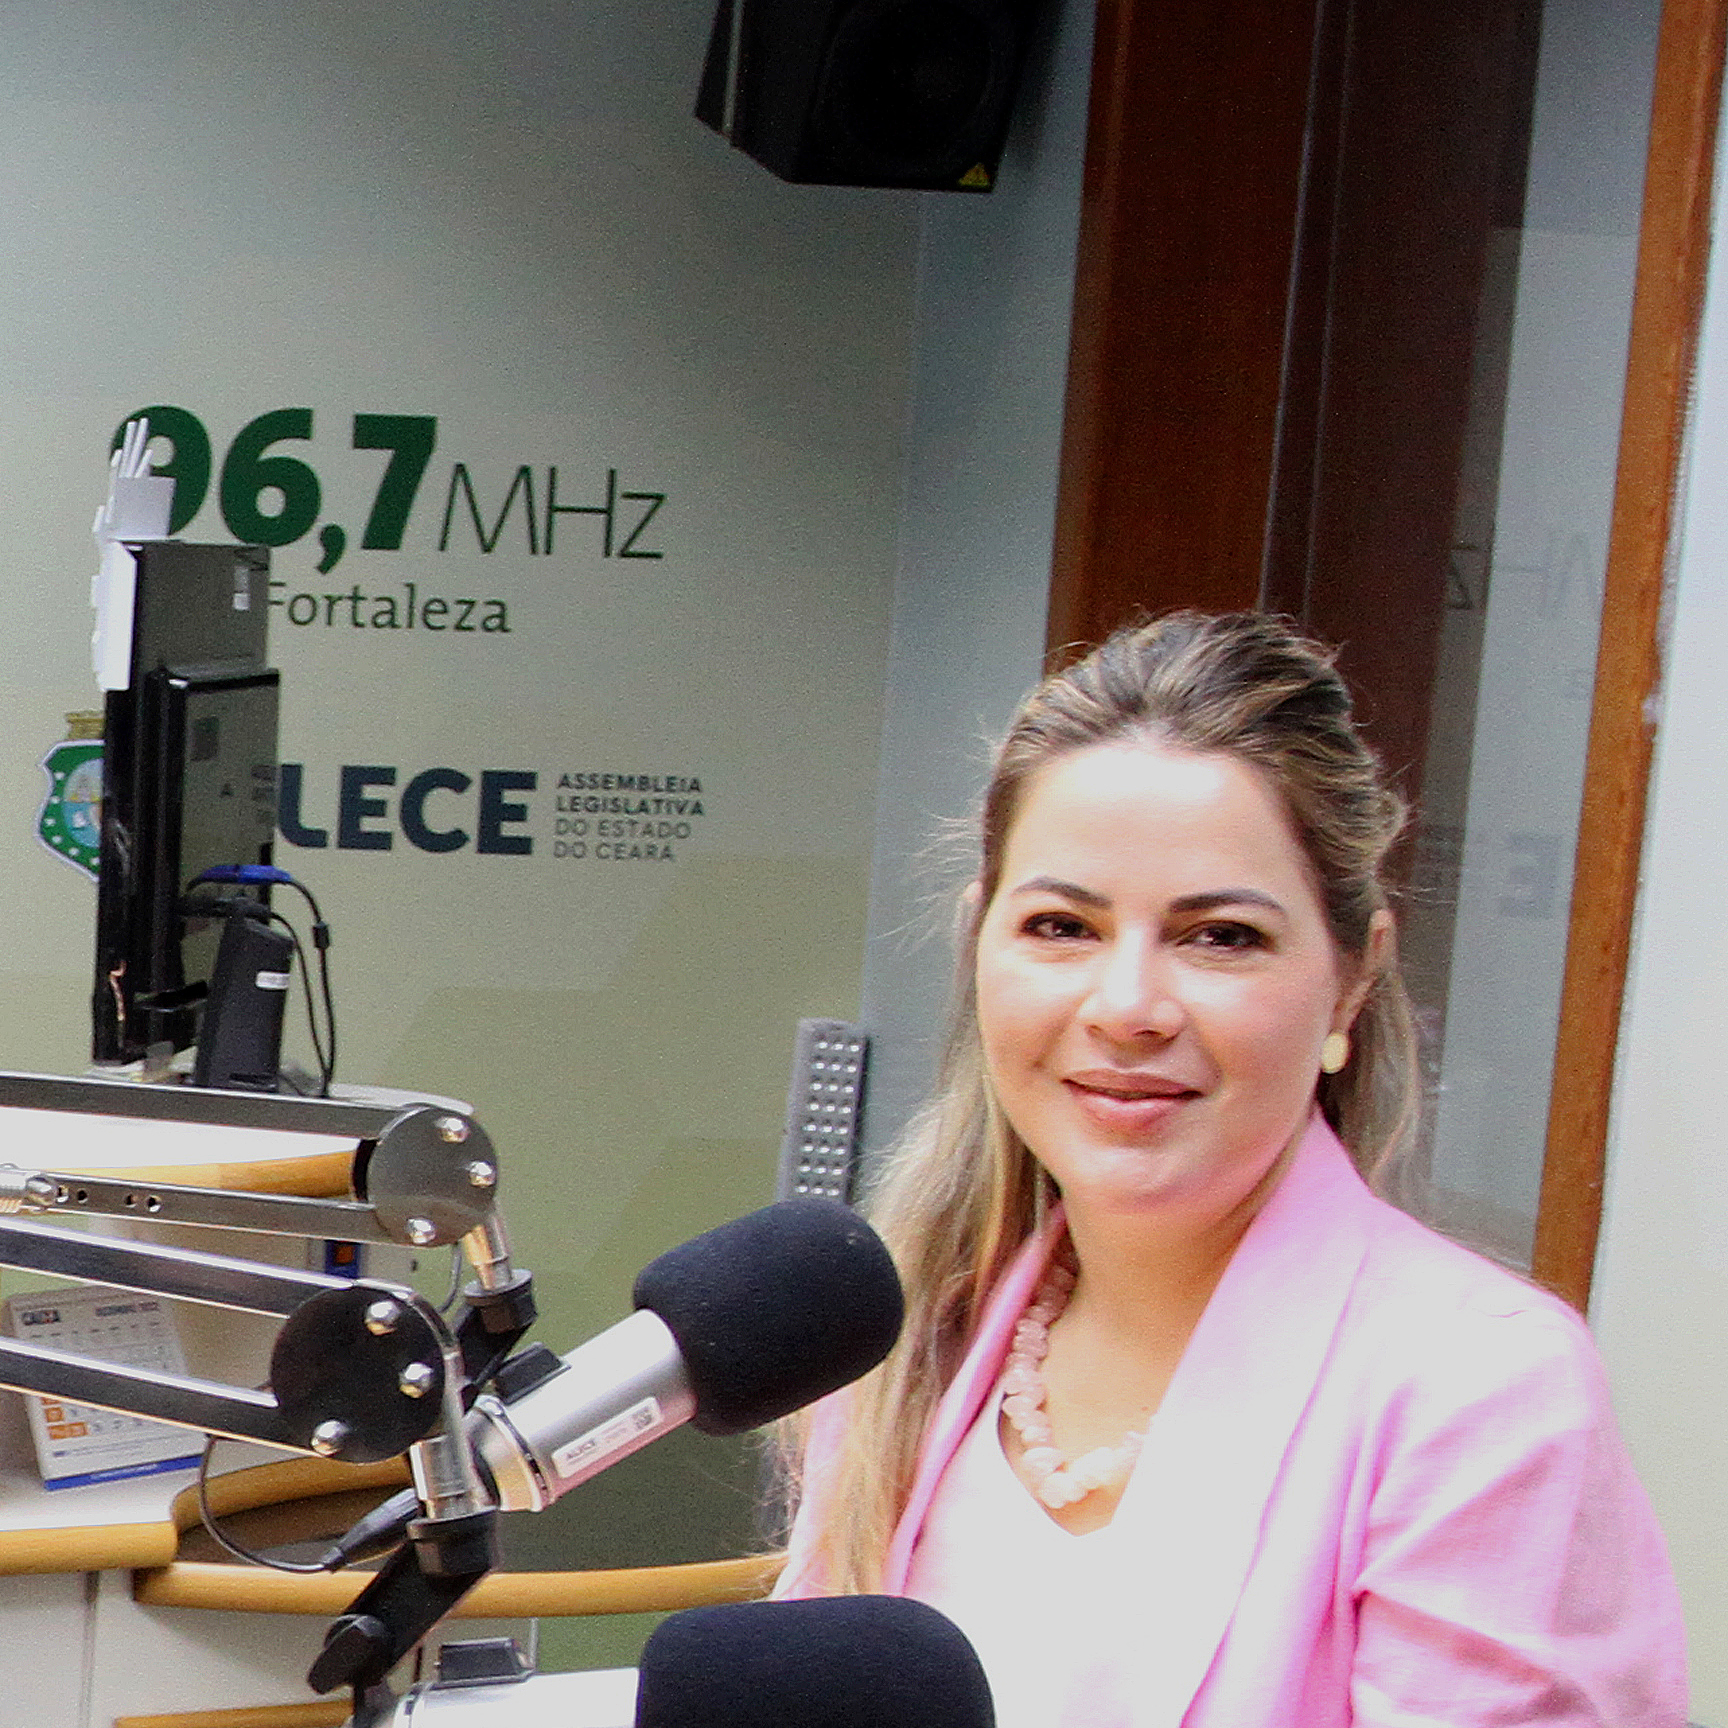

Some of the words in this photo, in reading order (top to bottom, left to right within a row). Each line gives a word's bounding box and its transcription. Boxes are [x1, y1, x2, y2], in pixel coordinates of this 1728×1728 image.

[110, 405, 438, 576] 96,7
[440, 462, 668, 559] MHz
[558, 773, 701, 792] ASSEMBLEIA
[278, 763, 538, 855] LECE
[556, 795, 705, 816] LEGISLATIVA
[555, 818, 587, 835] DO
[598, 819, 691, 838] ESTADO
[553, 840, 587, 859] DO
